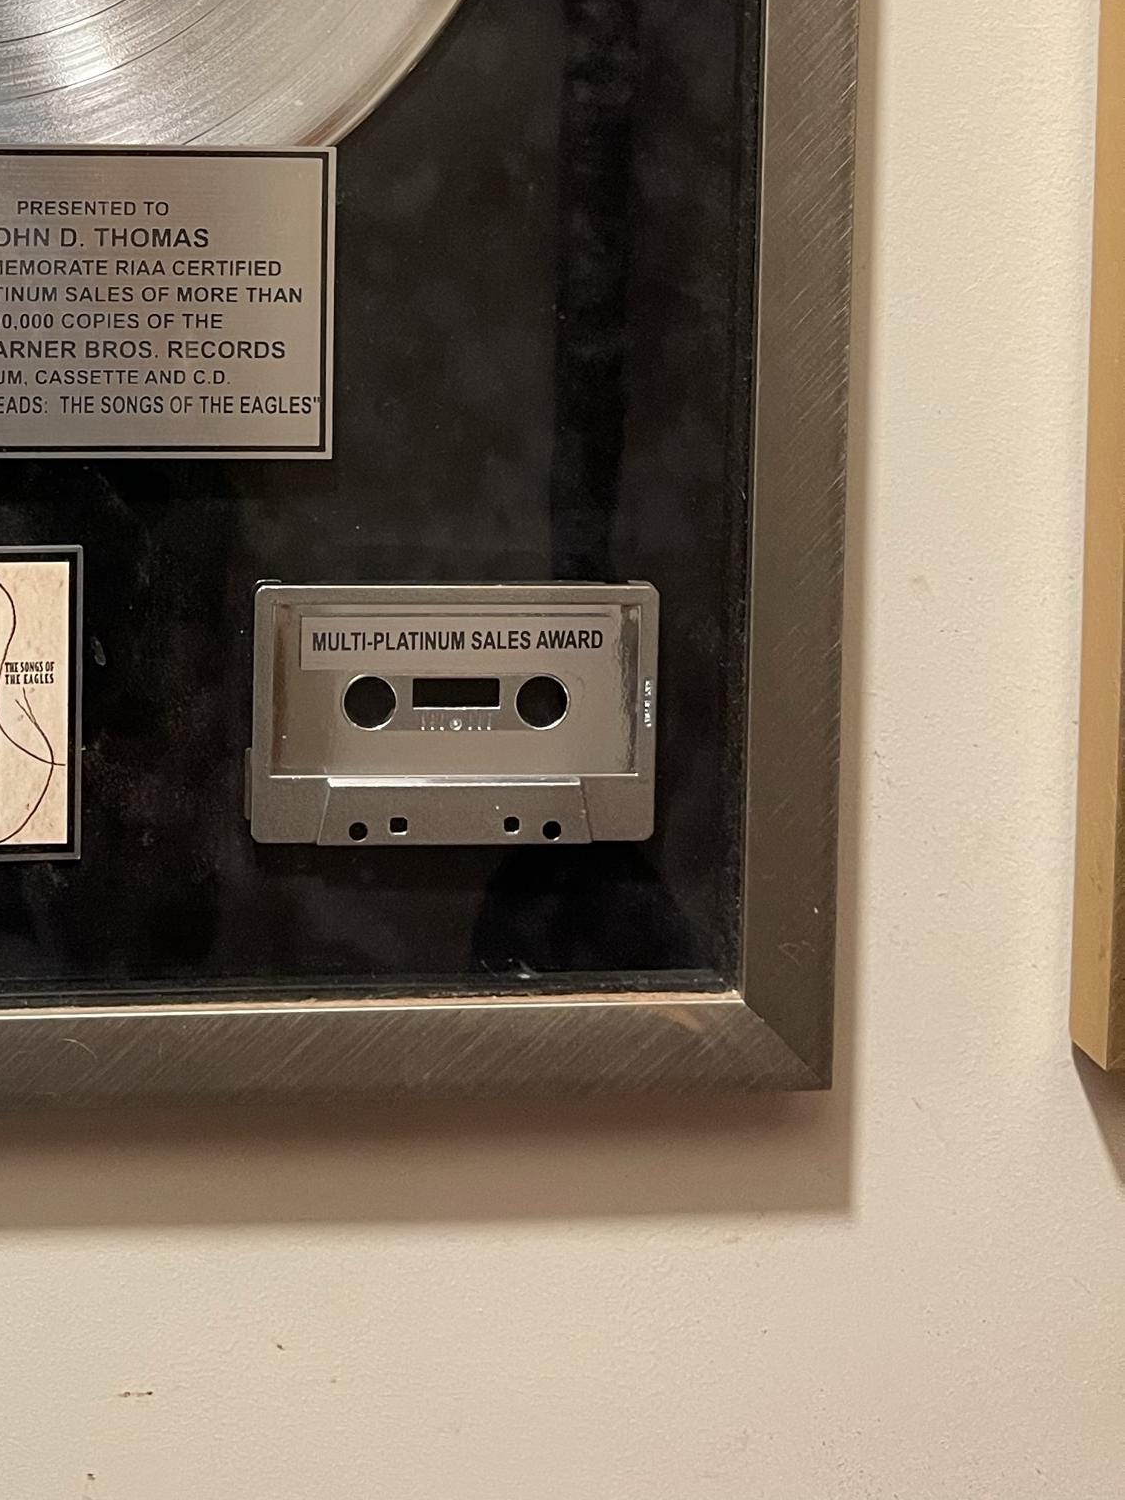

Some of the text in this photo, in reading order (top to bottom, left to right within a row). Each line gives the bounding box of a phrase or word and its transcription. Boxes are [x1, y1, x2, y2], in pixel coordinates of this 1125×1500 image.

[17, 201, 169, 216] PRESENTED TO
[60, 228, 84, 247] D.
[94, 228, 209, 247] THOMAS
[116, 260, 166, 276] RIAA
[173, 260, 282, 276] CERTIFIED
[65, 287, 134, 303] SALES
[142, 287, 169, 303] OF
[177, 287, 238, 303] MORE
[246, 287, 302, 303] THAN
[61, 313, 139, 329] COPIES
[147, 313, 175, 329] OF
[182, 313, 223, 329] THE
[85, 340, 158, 359] BROS.
[168, 340, 285, 359] RECORDS
[35, 370, 138, 385] CASSETTE
[144, 370, 186, 385] AND
[193, 370, 231, 385] C.D.
[60, 397, 94, 414] THE
[101, 397, 164, 414] SONGS
[170, 397, 193, 414] OF
[199, 397, 233, 414] THE
[240, 397, 320, 414] EAGLES"
[313, 630, 603, 650] MULTI-PLATINUM SALES AWARD
[4, 661, 55, 673] THE SONGS OF
[4, 674, 54, 685] THE EAGLES
